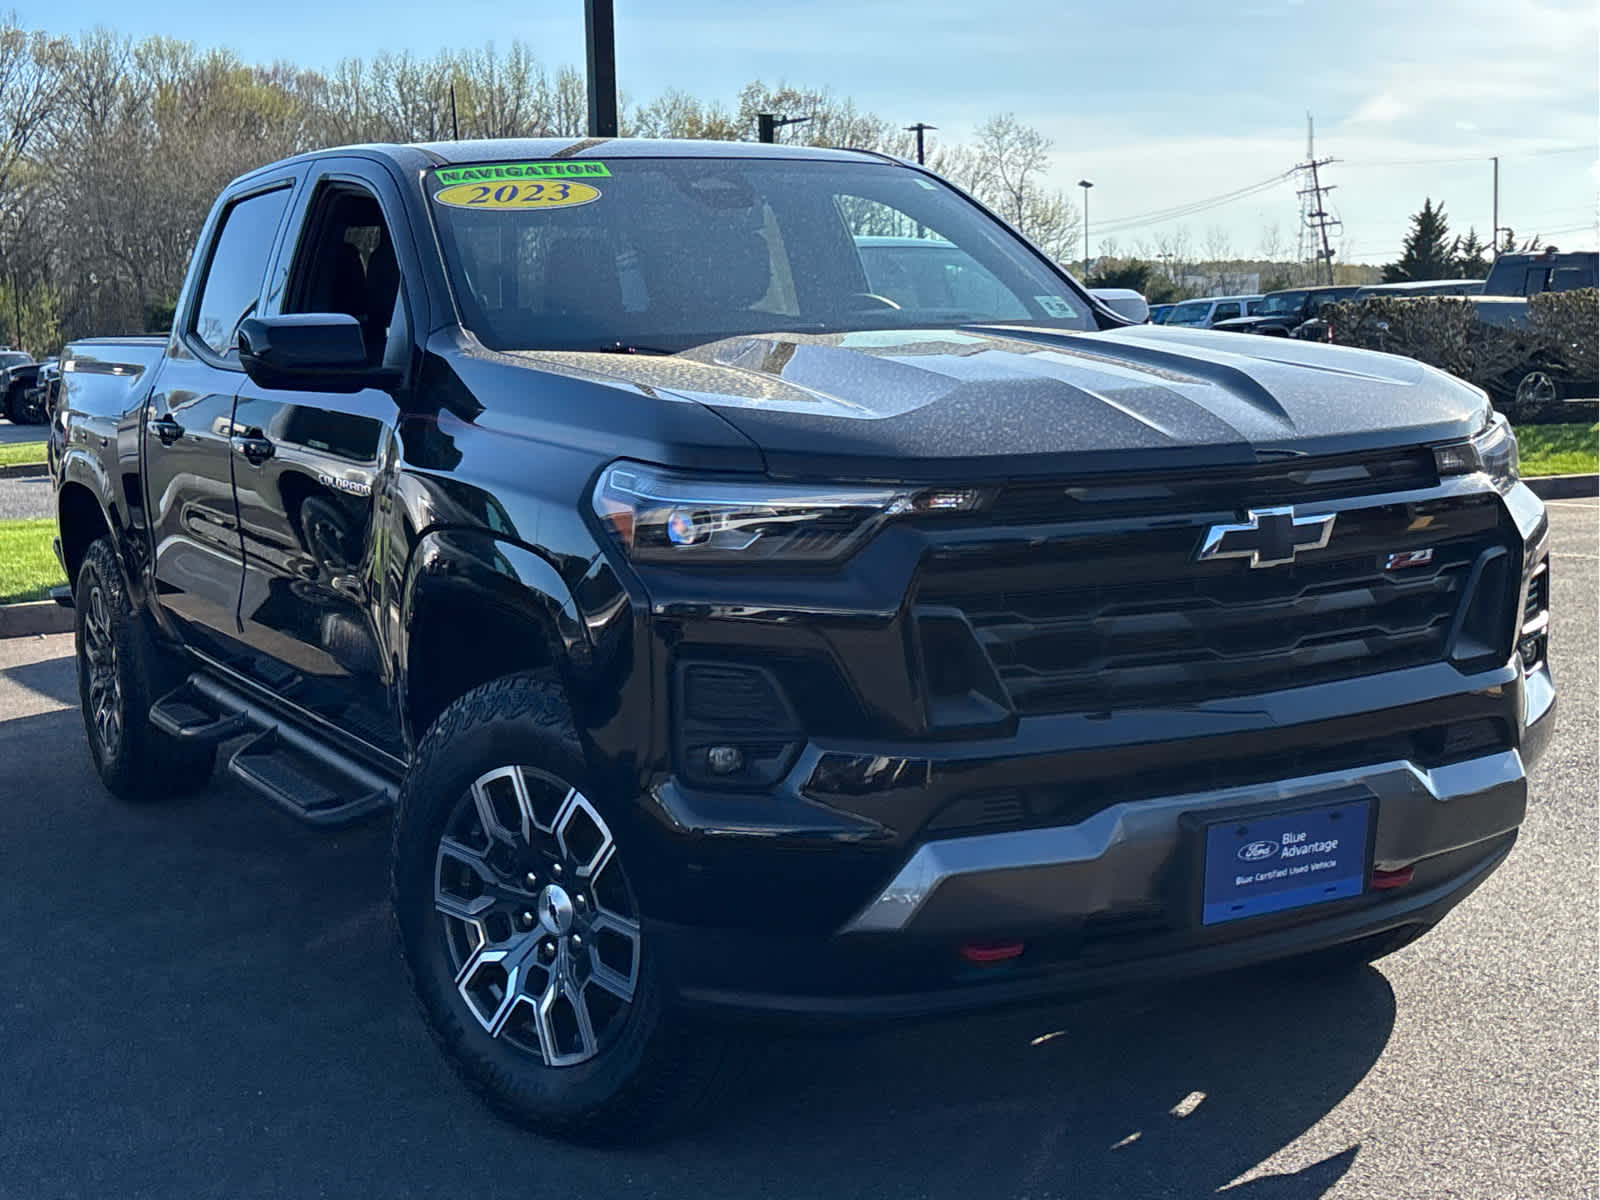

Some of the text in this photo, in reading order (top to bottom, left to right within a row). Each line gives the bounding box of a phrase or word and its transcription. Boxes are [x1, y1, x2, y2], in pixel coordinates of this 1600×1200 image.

[441, 163, 603, 182] NAVIGATION
[467, 183, 571, 204] 2023
[318, 473, 371, 495] COLORADO
[1282, 832, 1307, 844] Blue
[1245, 843, 1271, 857] Ford
[1280, 839, 1338, 859] Advantage
[1235, 860, 1337, 886] Blue Certified Used Vehicle
